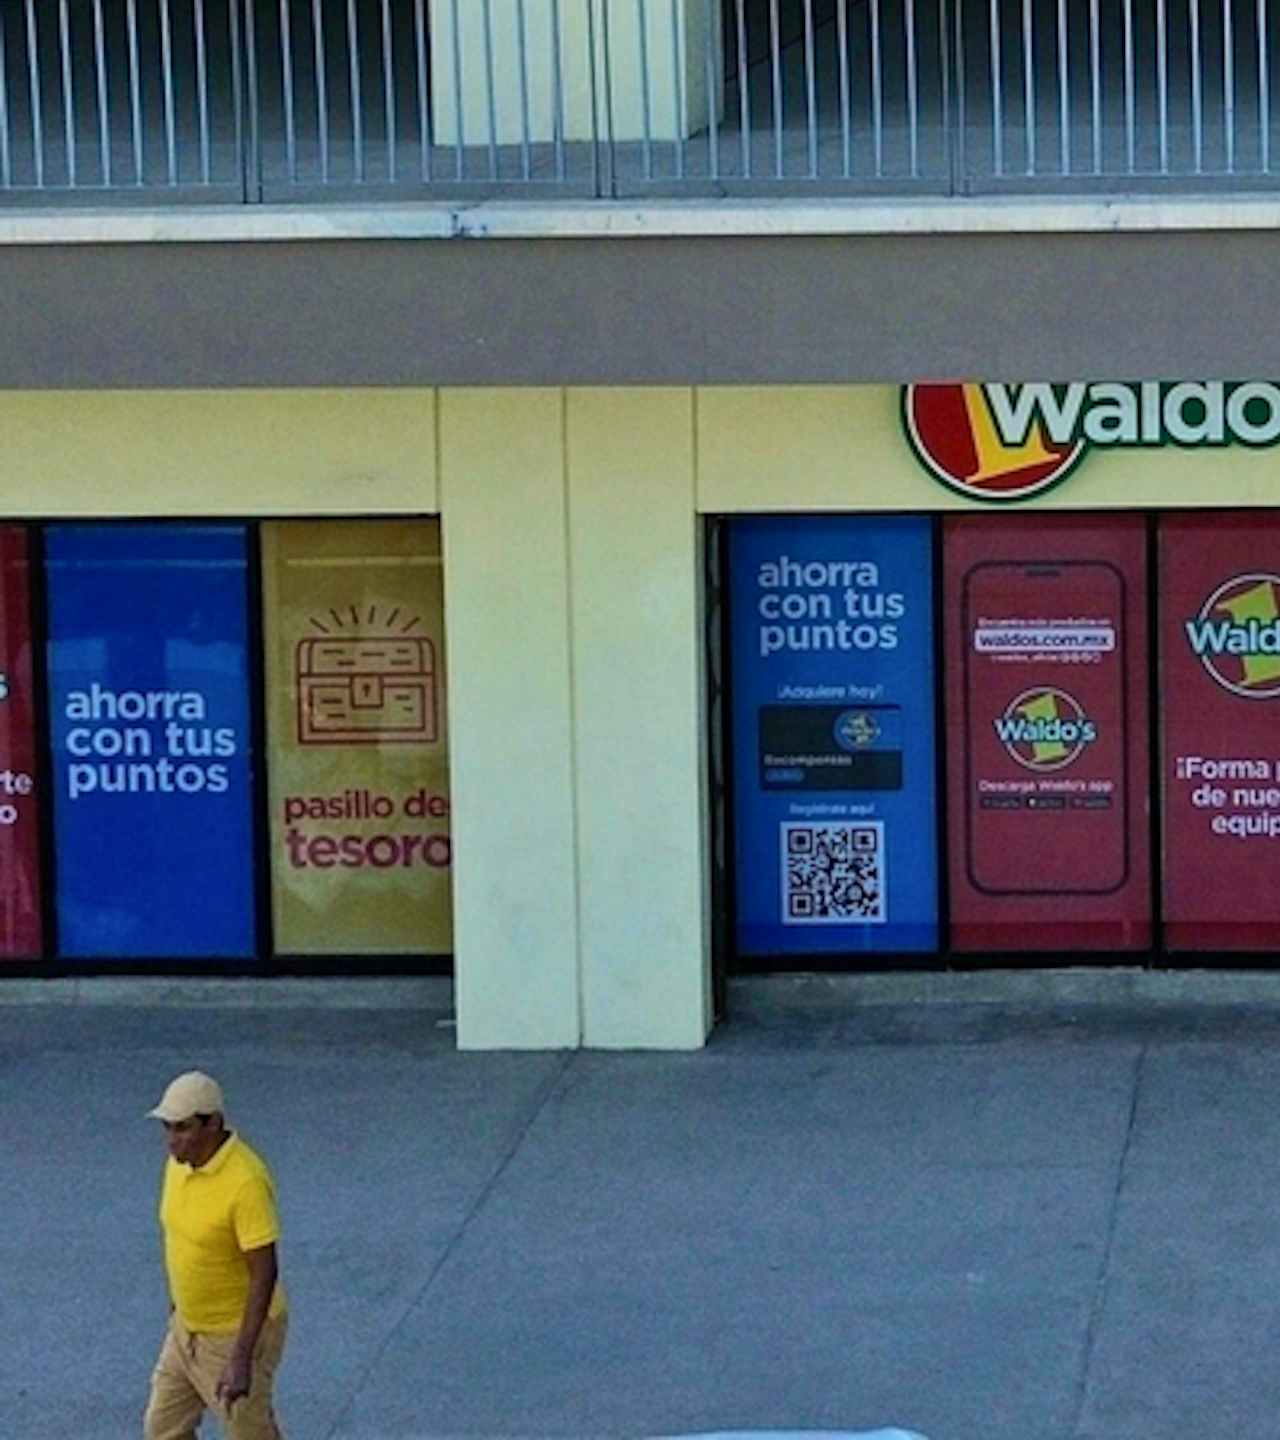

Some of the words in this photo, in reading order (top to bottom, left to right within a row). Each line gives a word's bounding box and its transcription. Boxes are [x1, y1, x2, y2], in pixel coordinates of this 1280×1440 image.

[758, 556, 879, 587] ahorra
[759, 593, 831, 619] con
[844, 588, 905, 618] tus
[760, 620, 898, 657] puntos
[979, 632, 1109, 647] waldos.com.mx
[65, 683, 205, 719] ahorra
[66, 727, 151, 756] con
[165, 721, 236, 756] tus
[995, 718, 1097, 741] Waldo's
[69, 758, 229, 799] puntos
[1176, 757, 1270, 779] ¡Forma
[285, 789, 394, 824] pasillo
[404, 788, 451, 817] de
[1192, 784, 1226, 807] de
[286, 829, 453, 868] tesoro
